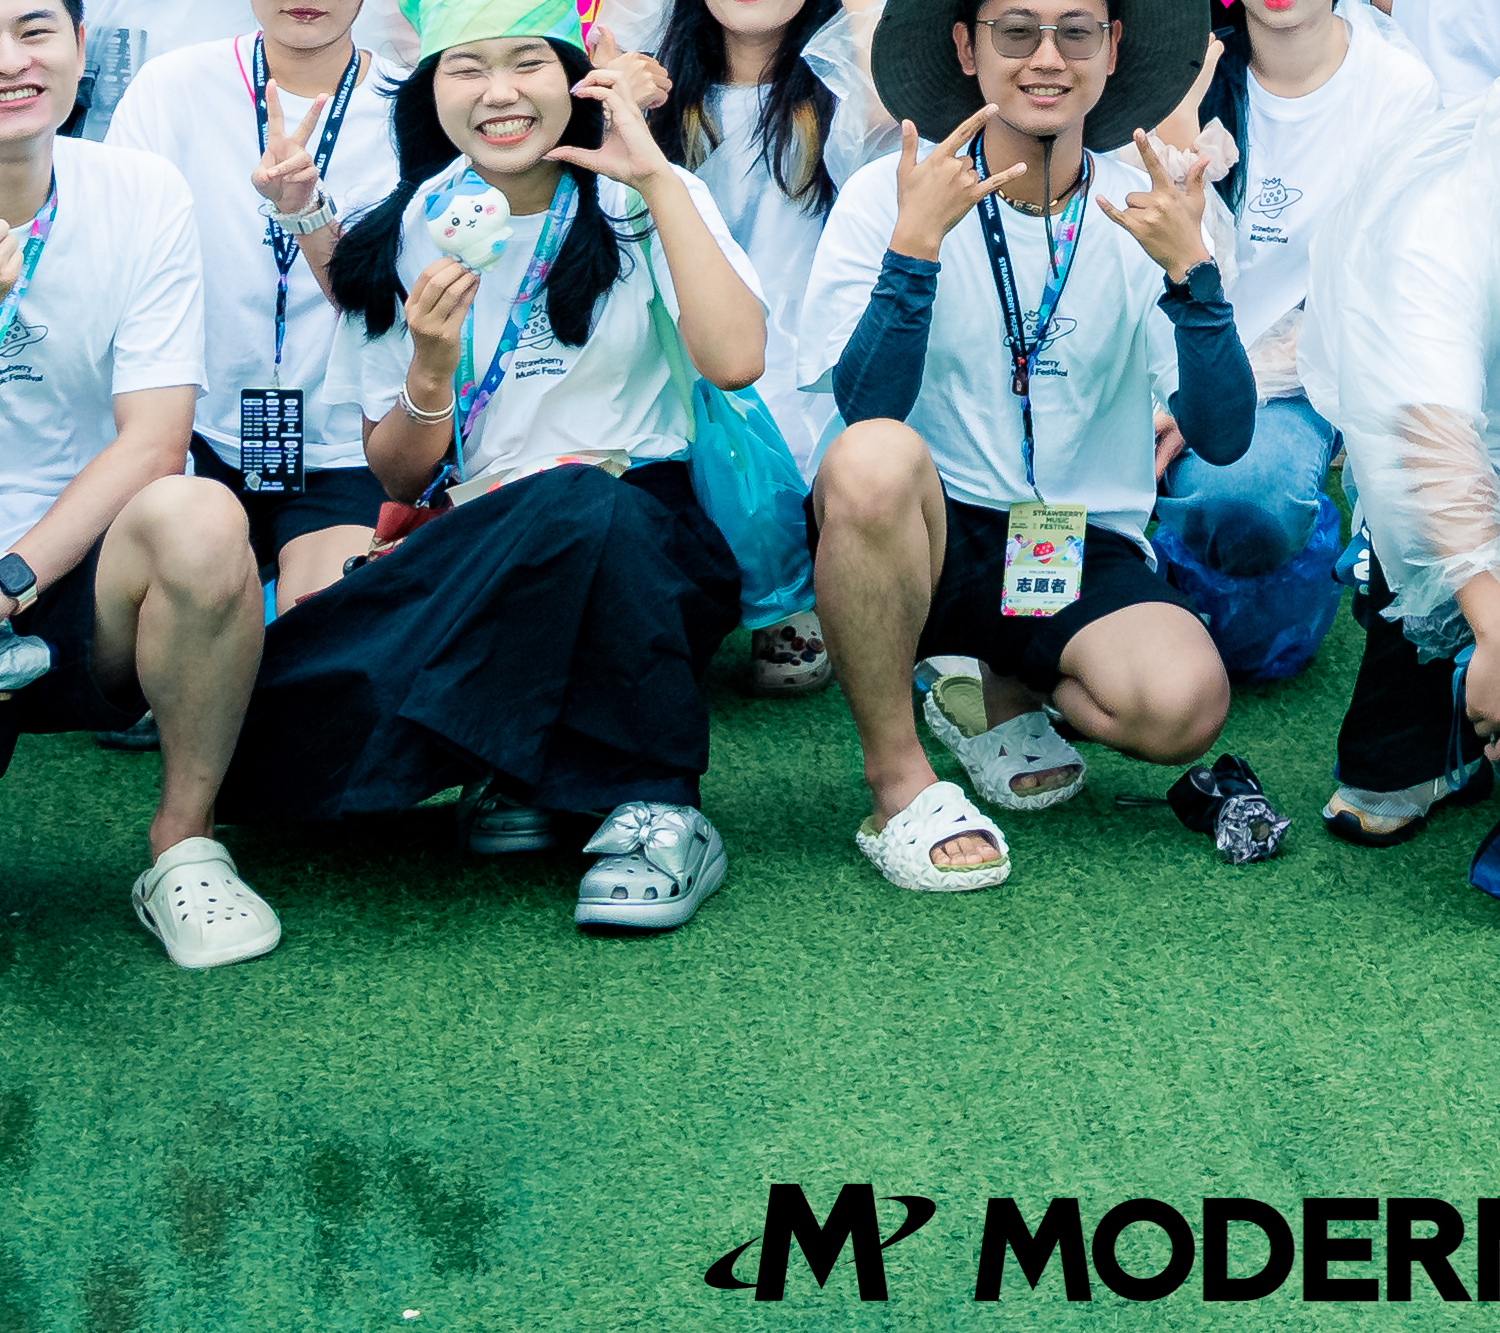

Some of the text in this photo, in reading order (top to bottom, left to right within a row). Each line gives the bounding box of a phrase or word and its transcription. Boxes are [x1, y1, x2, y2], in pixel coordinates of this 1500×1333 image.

[331, 85, 350, 120] FESTIVAL
[998, 256, 1017, 314] STRAWBERRY
[514, 357, 564, 369] Strawberry
[515, 369, 541, 379] Music
[1034, 368, 1068, 377] Festival
[8, 374, 44, 384] Festival
[1032, 510, 1085, 518] STRAWBERRY
[1039, 523, 1075, 531] FESTIVAL
[1016, 577, 1067, 594] 志愿者
